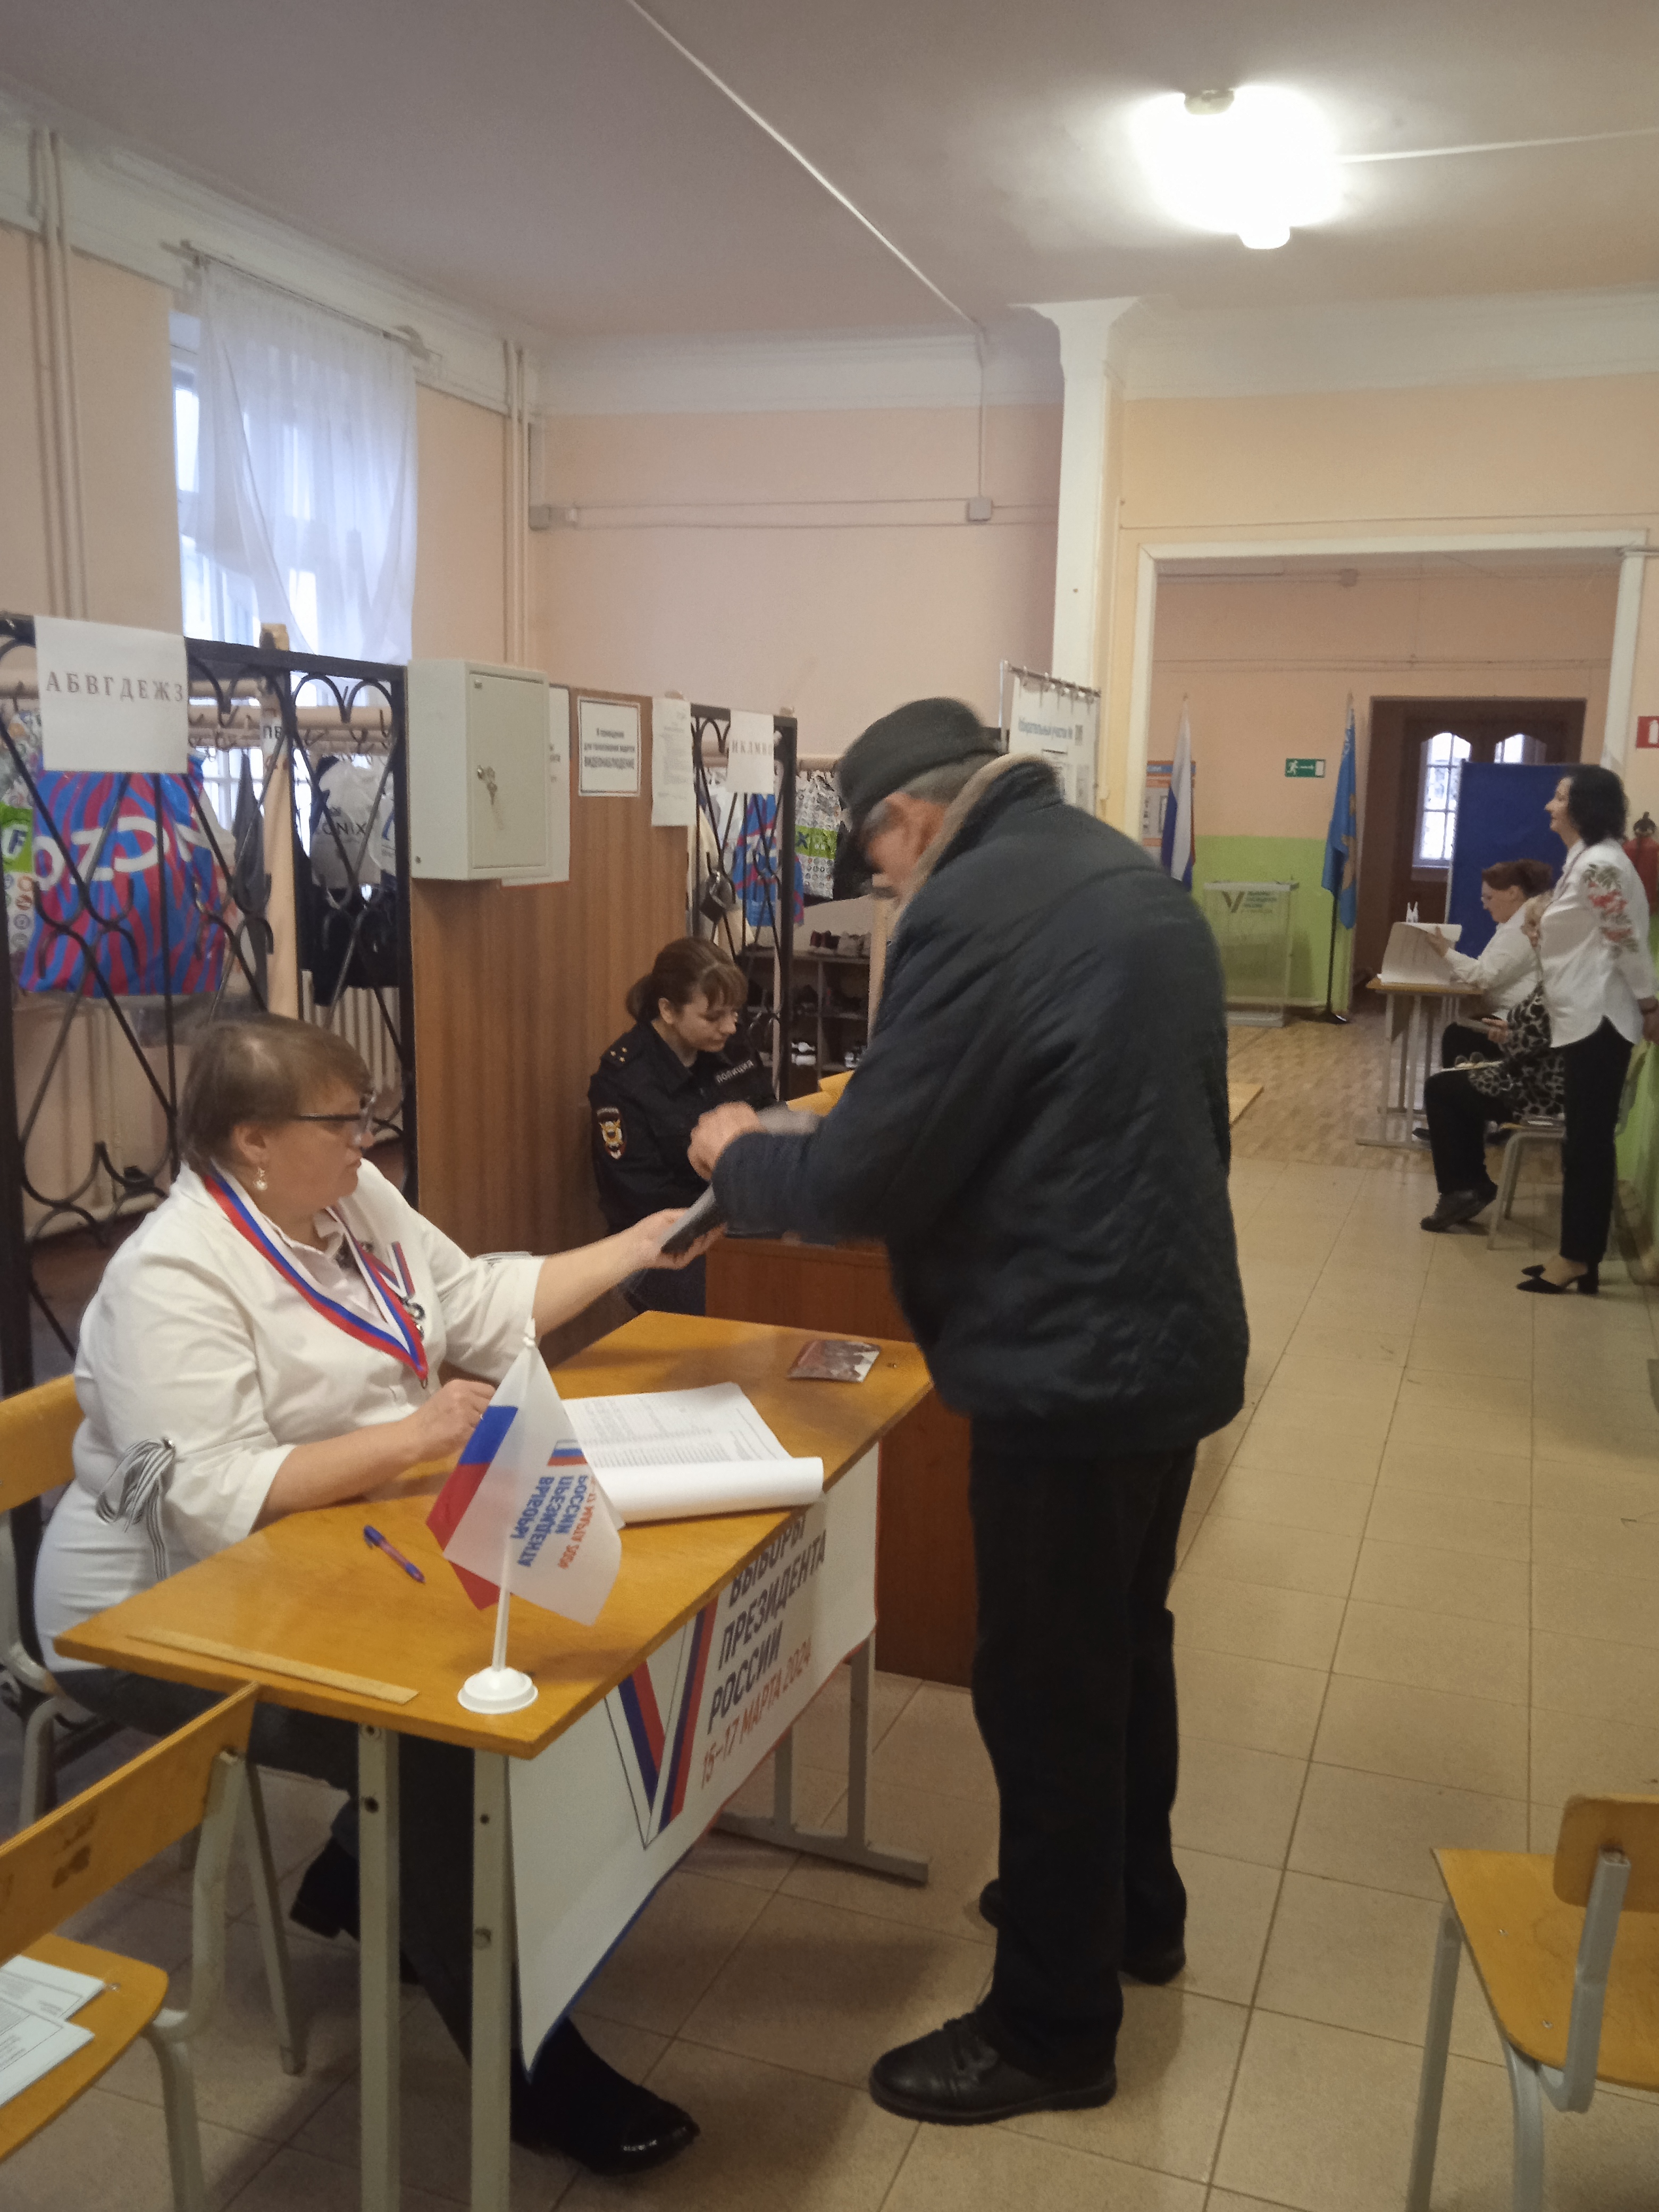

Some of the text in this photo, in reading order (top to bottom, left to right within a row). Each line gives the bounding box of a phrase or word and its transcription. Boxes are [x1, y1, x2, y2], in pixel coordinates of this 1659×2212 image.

[46, 671, 183, 702] АБВГДЕЖЗ
[718, 1529, 827, 1671] ПРЕЗИДЕНТА
[707, 1620, 783, 1735] РОССИИ
[739, 1668, 782, 1745] МАРТА
